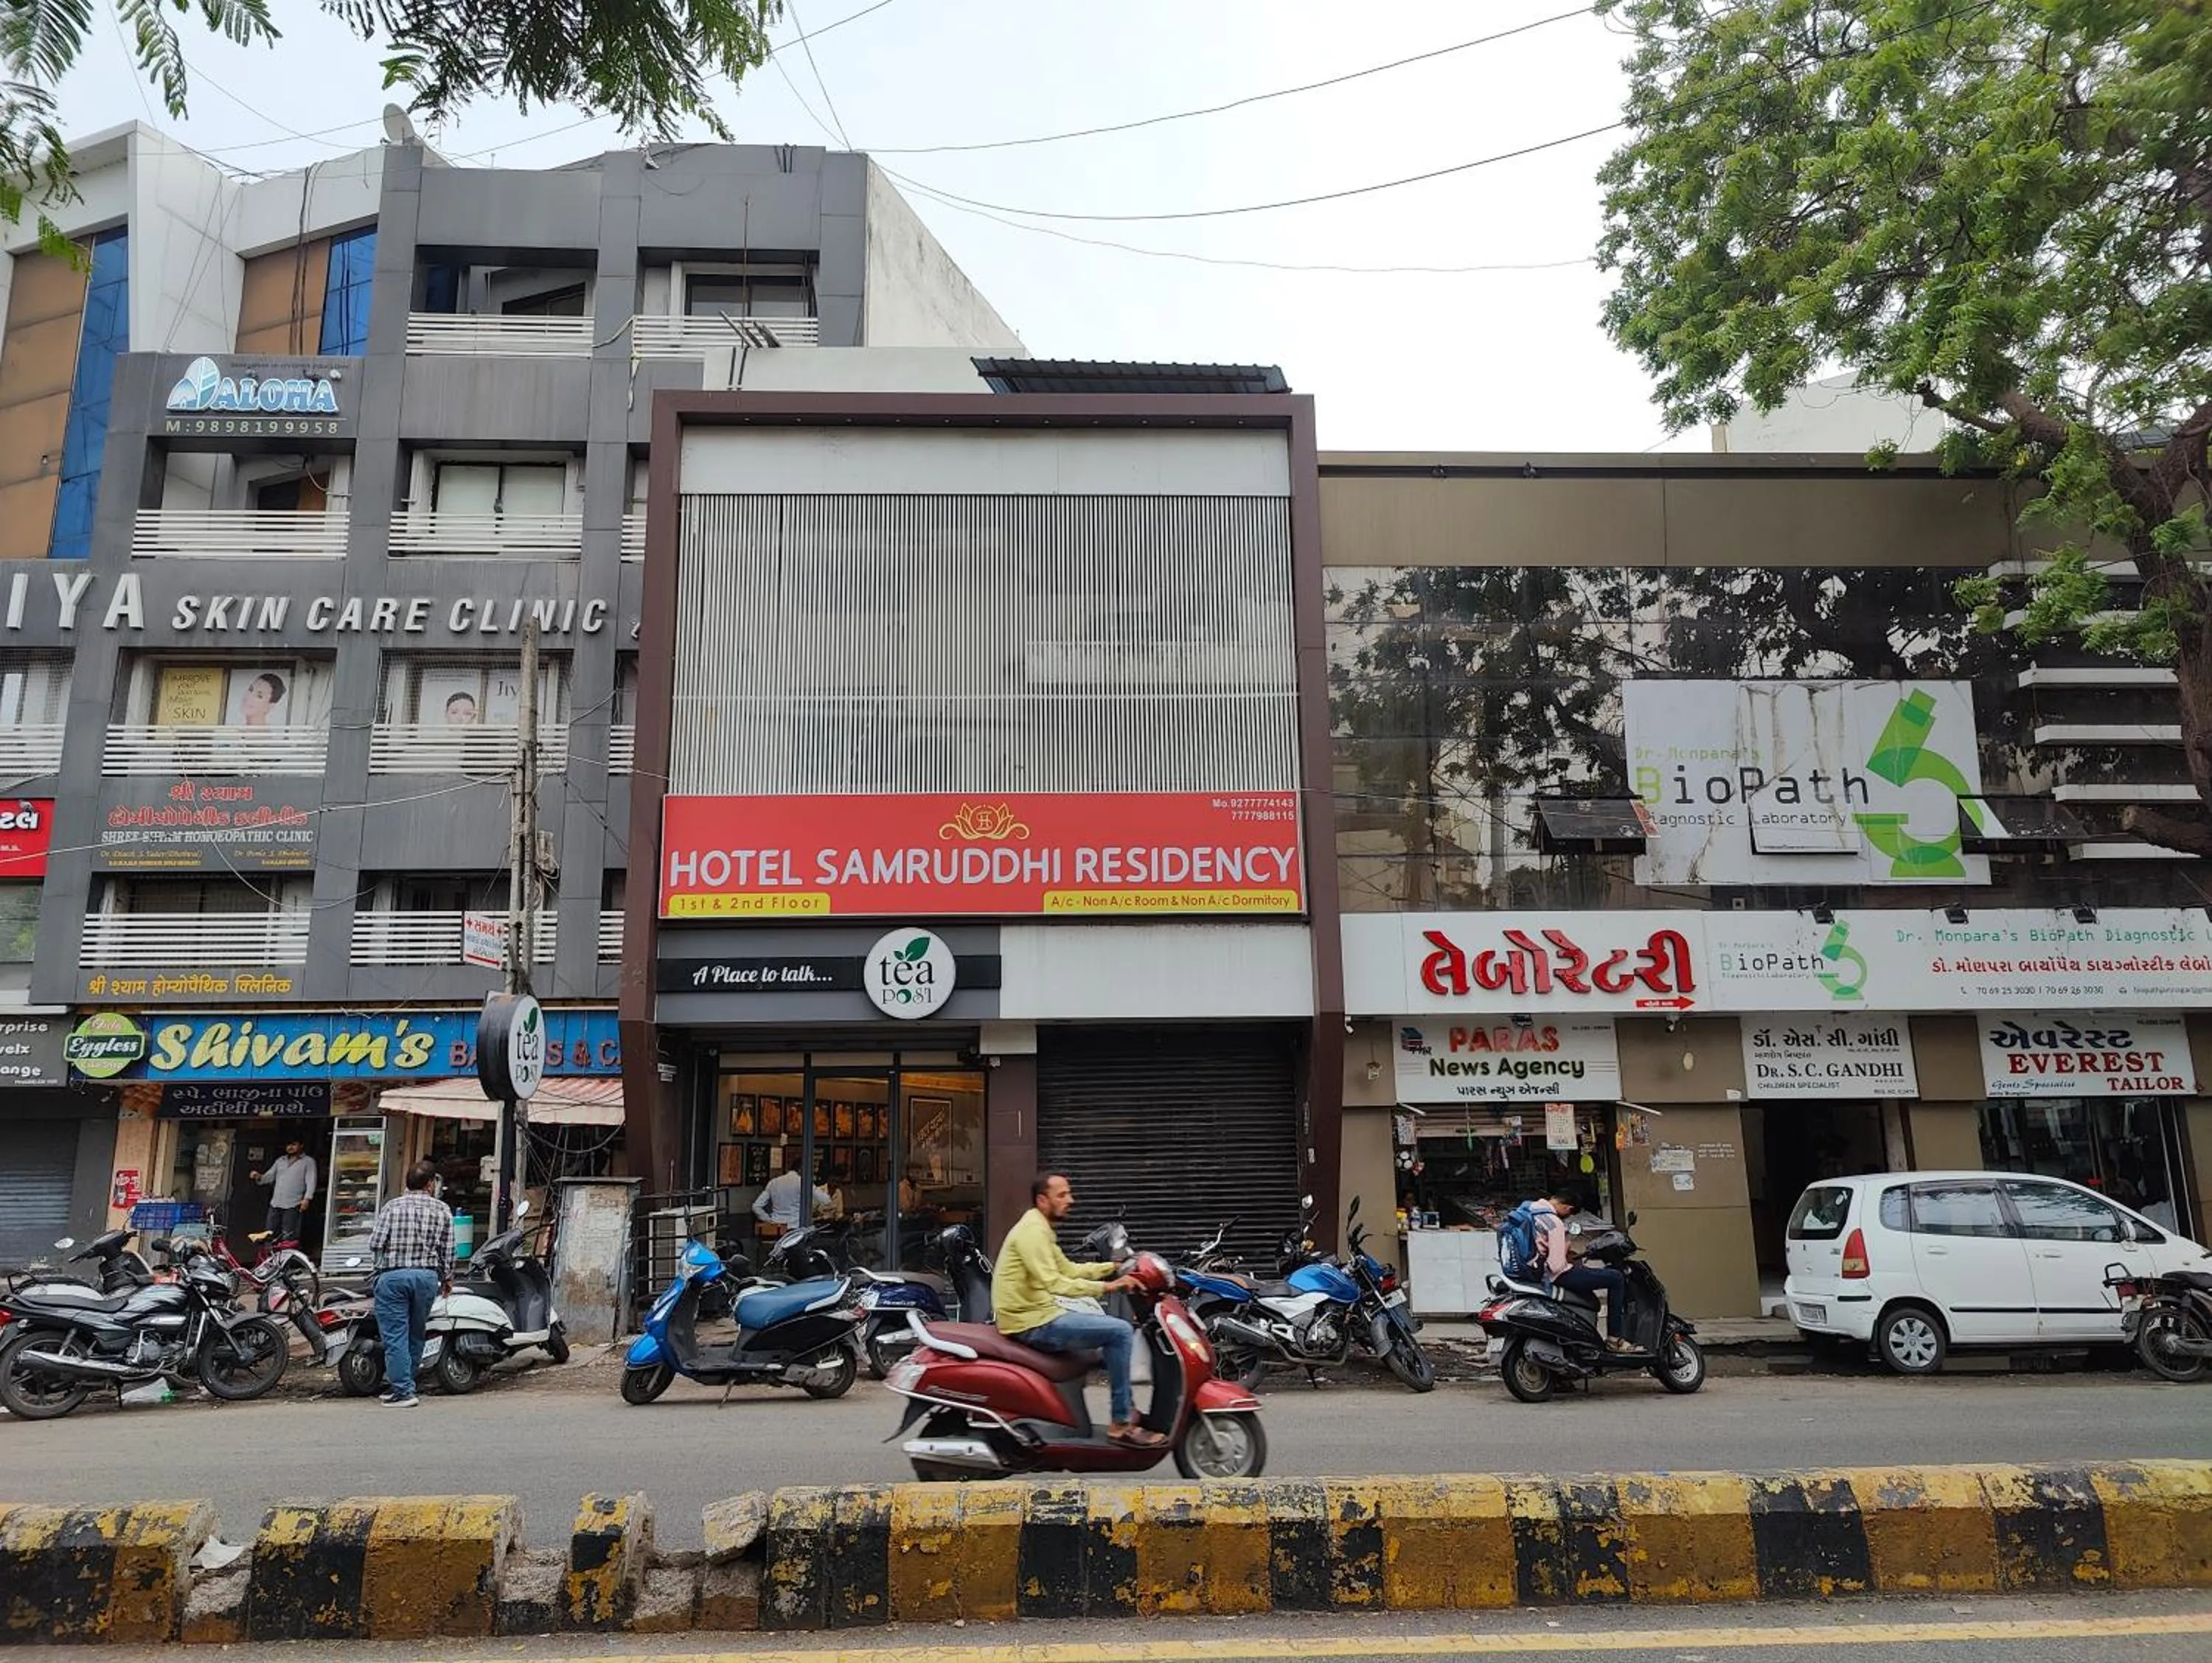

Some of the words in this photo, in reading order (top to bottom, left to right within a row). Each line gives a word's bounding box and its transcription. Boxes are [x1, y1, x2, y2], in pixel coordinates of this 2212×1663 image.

[209, 377, 340, 412] ALOHA
[172, 595, 291, 632] SKIN
[306, 596, 432, 632] CARE
[448, 598, 608, 634] CLINIC
[173, 707, 206, 719] SKIN
[1635, 764, 1869, 806] BioPath
[1644, 812, 1735, 827] iagnostic
[1752, 811, 1846, 826] Laboratory
[276, 830, 313, 843] CLINIC
[669, 848, 803, 887] HOTEL
[815, 847, 1061, 885] SAMRUDDHI
[1074, 846, 1295, 884] RESIDENCY
[680, 897, 706, 911] 1st
[712, 897, 723, 910] &
[729, 896, 764, 910] 2nd
[771, 896, 821, 910] Floor
[1082, 896, 1110, 907] Non
[1134, 896, 1169, 907] Room
[1171, 896, 1180, 906] &
[1181, 896, 1206, 906] Non
[1232, 894, 1290, 907] Dormitory
[1896, 930, 1922, 942] Dr.
[1935, 929, 2019, 943] Monpara's
[2029, 929, 2095, 941] BioPath
[2105, 928, 2195, 944] Diagnostic
[879, 956, 935, 986] tea
[1420, 929, 1697, 995] લેબોરેટરી
[1720, 952, 1824, 971] BioPath
[88, 973, 107, 996] श्री
[111, 979, 147, 996] श्याम
[152, 973, 229, 997] होम्योपैथिक
[234, 973, 293, 995] क्लिनिक
[692, 966, 709, 986] A
[712, 966, 758, 984] Place
[762, 966, 779, 982] to
[780, 966, 833, 983] talk...
[149, 1019, 435, 1071] Shivam's
[517, 1025, 540, 1061] tea
[1448, 1025, 1560, 1053] PARAS
[1782, 1028, 1821, 1047] એસ.
[1826, 1028, 1853, 1047] સી.
[1857, 1028, 1900, 1047] ગાંધી
[1989, 1020, 2133, 1050] એવરેસ્ટ
[69, 1037, 139, 1058] Eggless
[1429, 1058, 1490, 1077] News
[1497, 1057, 1586, 1079] Agency
[1787, 1063, 1802, 1078] S.
[1805, 1063, 1822, 1078] C.
[1826, 1062, 1905, 1078] GANDHI
[2007, 1051, 2165, 1074] EVEREST
[1456, 1084, 1487, 1096] પારસ
[1518, 1082, 1560, 1095] એજન્સી
[1757, 1081, 1796, 1090] CHILDREN
[1797, 1081, 1840, 1090] SPECIALIST
[2107, 1076, 2185, 1091] TAILOR
